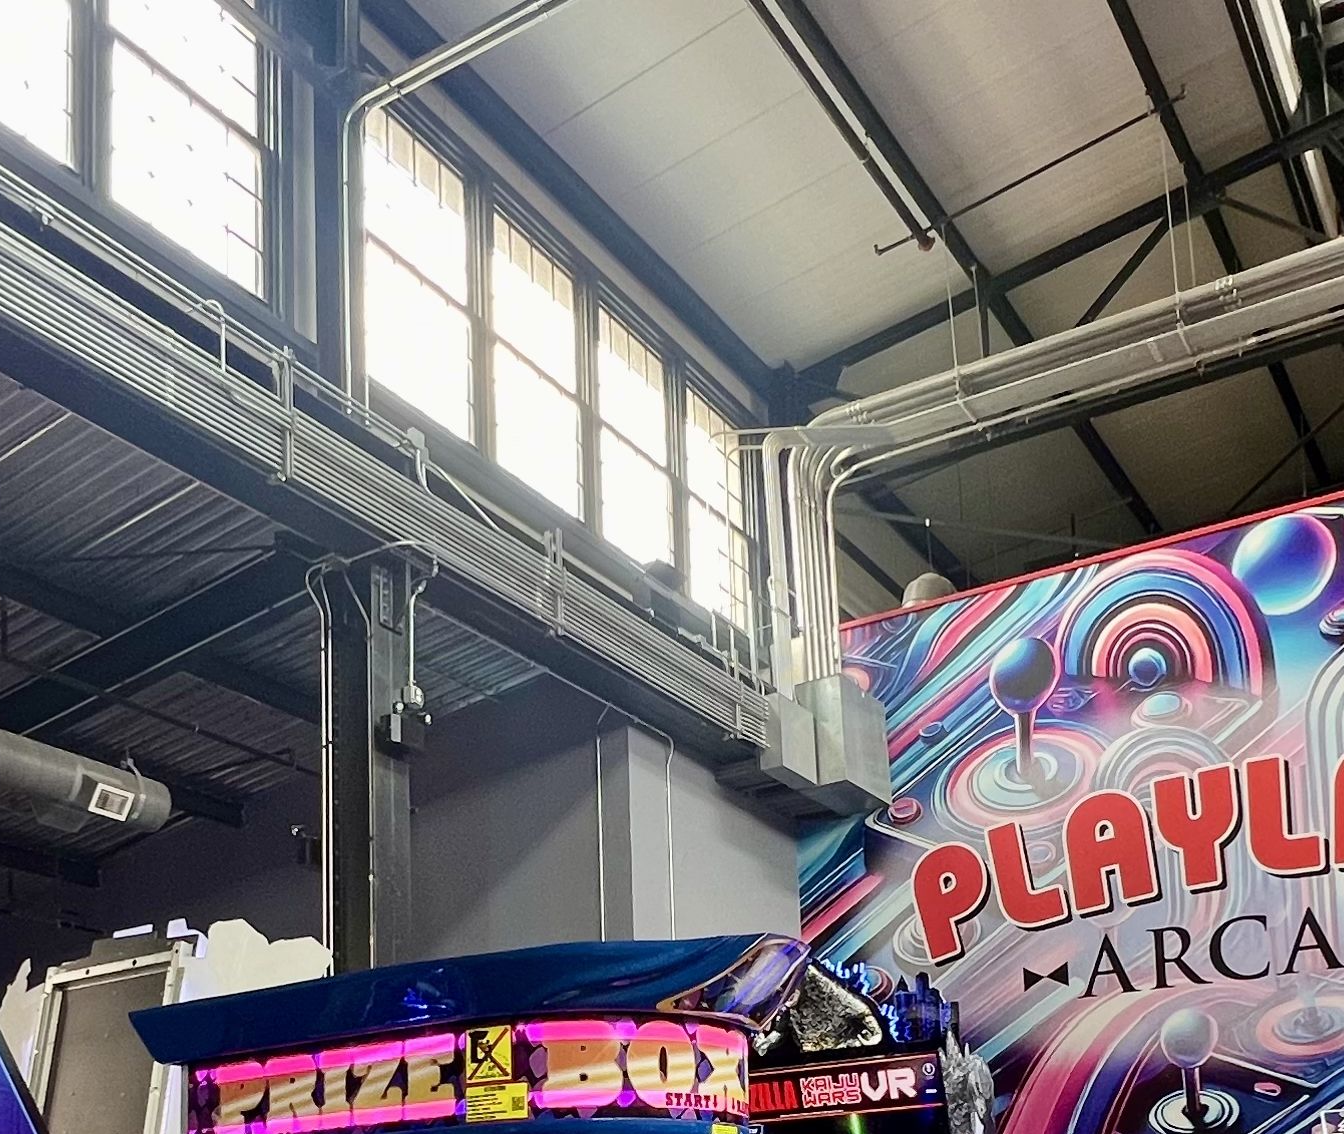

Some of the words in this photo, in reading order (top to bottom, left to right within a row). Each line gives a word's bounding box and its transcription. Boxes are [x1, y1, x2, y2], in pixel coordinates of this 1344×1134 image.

[524, 1019, 749, 1112] BOX
[800, 1073, 859, 1091] KAIJU
[861, 1067, 919, 1101] VR
[802, 1087, 862, 1108] WARS
